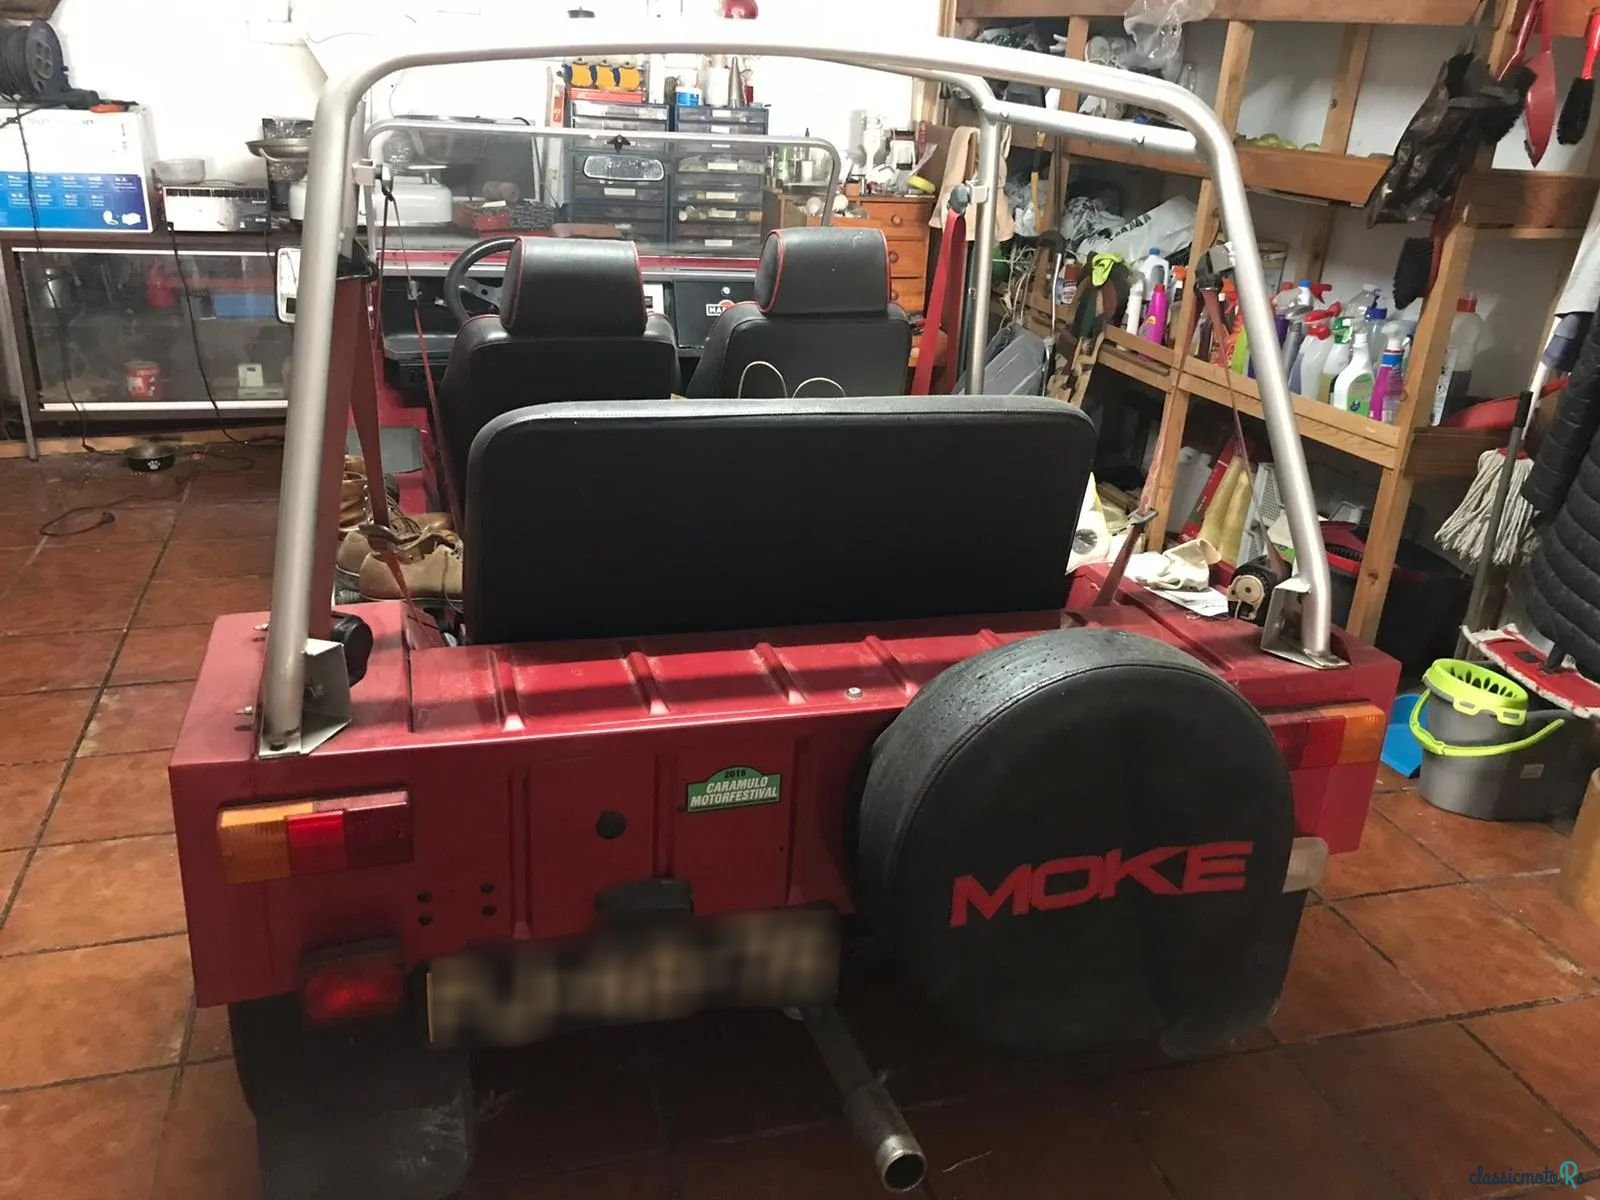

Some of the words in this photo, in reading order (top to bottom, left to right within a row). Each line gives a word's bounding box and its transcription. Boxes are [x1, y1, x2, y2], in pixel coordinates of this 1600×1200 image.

[706, 776, 768, 793] CARAMULO
[690, 786, 777, 807] MOTORFESTIVAL
[950, 841, 1253, 928] MOKE
